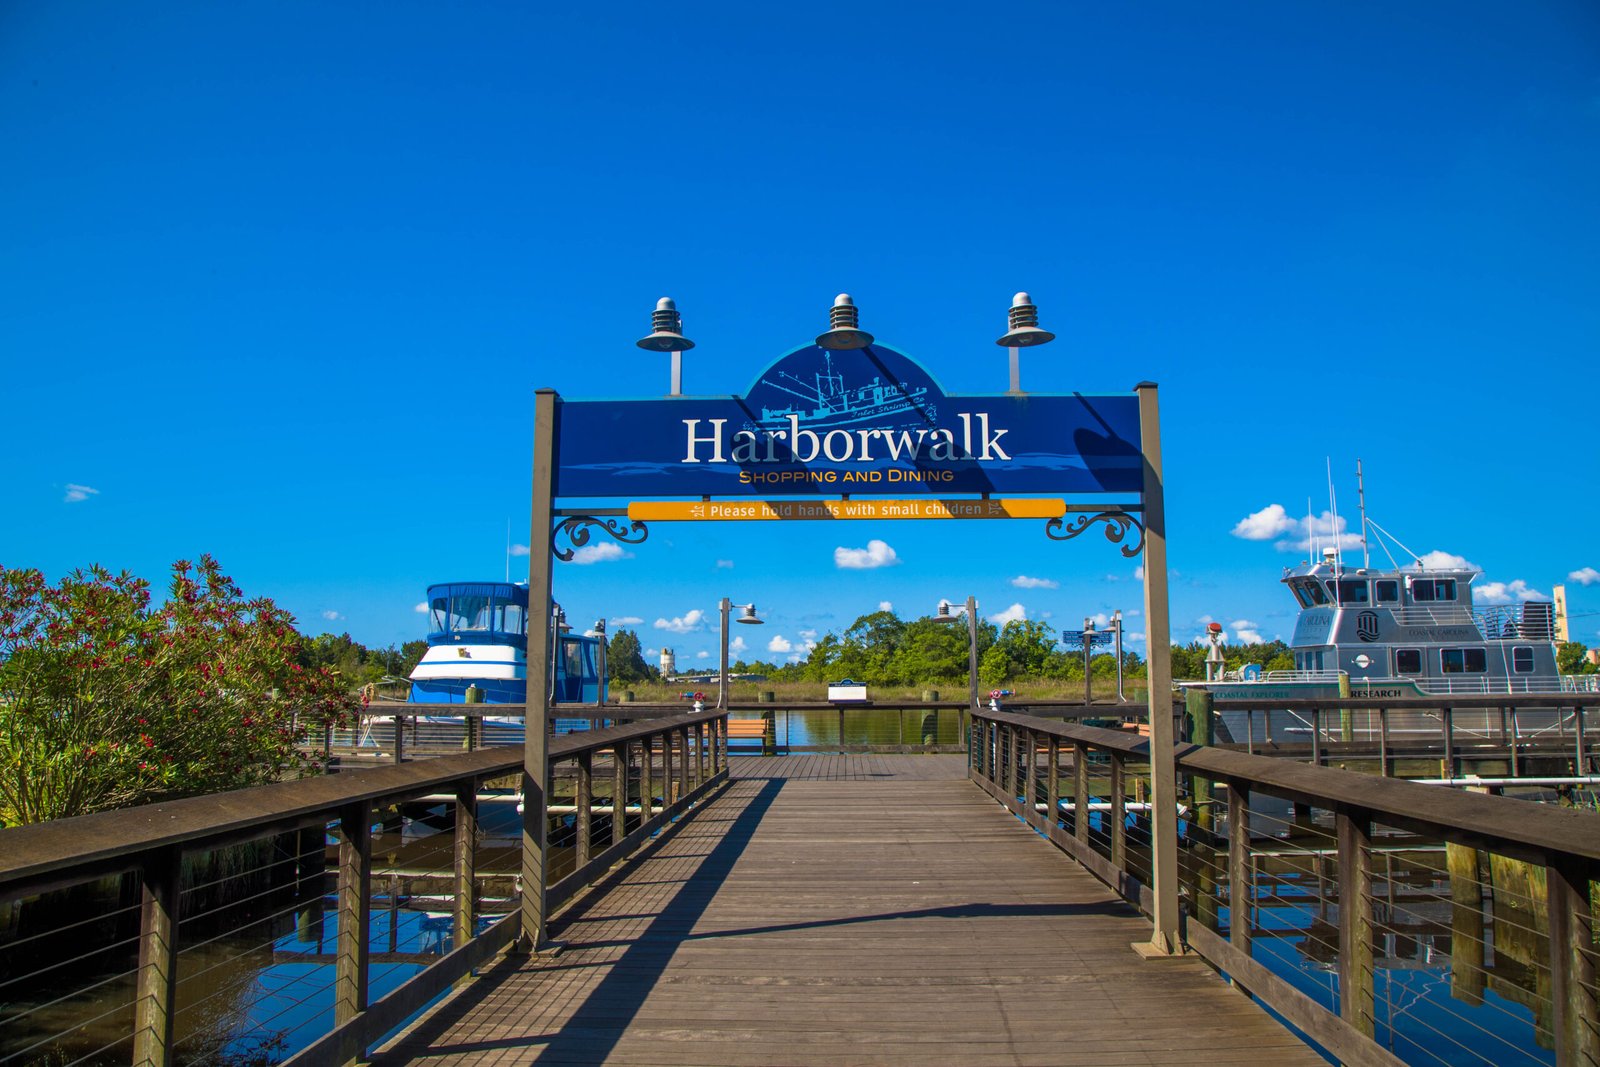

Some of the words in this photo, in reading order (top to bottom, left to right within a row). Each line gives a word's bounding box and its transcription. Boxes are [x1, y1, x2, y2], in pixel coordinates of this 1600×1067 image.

[682, 412, 1012, 463] Harborwalk
[739, 471, 837, 483] SHOPPING
[843, 471, 882, 482] AND
[888, 469, 954, 482] DINING
[710, 505, 756, 517] Please
[762, 505, 792, 516] hold
[798, 504, 839, 516] hands
[845, 503, 875, 516] with
[881, 503, 919, 515] small
[925, 503, 982, 515] children
[1351, 690, 1401, 698] RESEARCH
